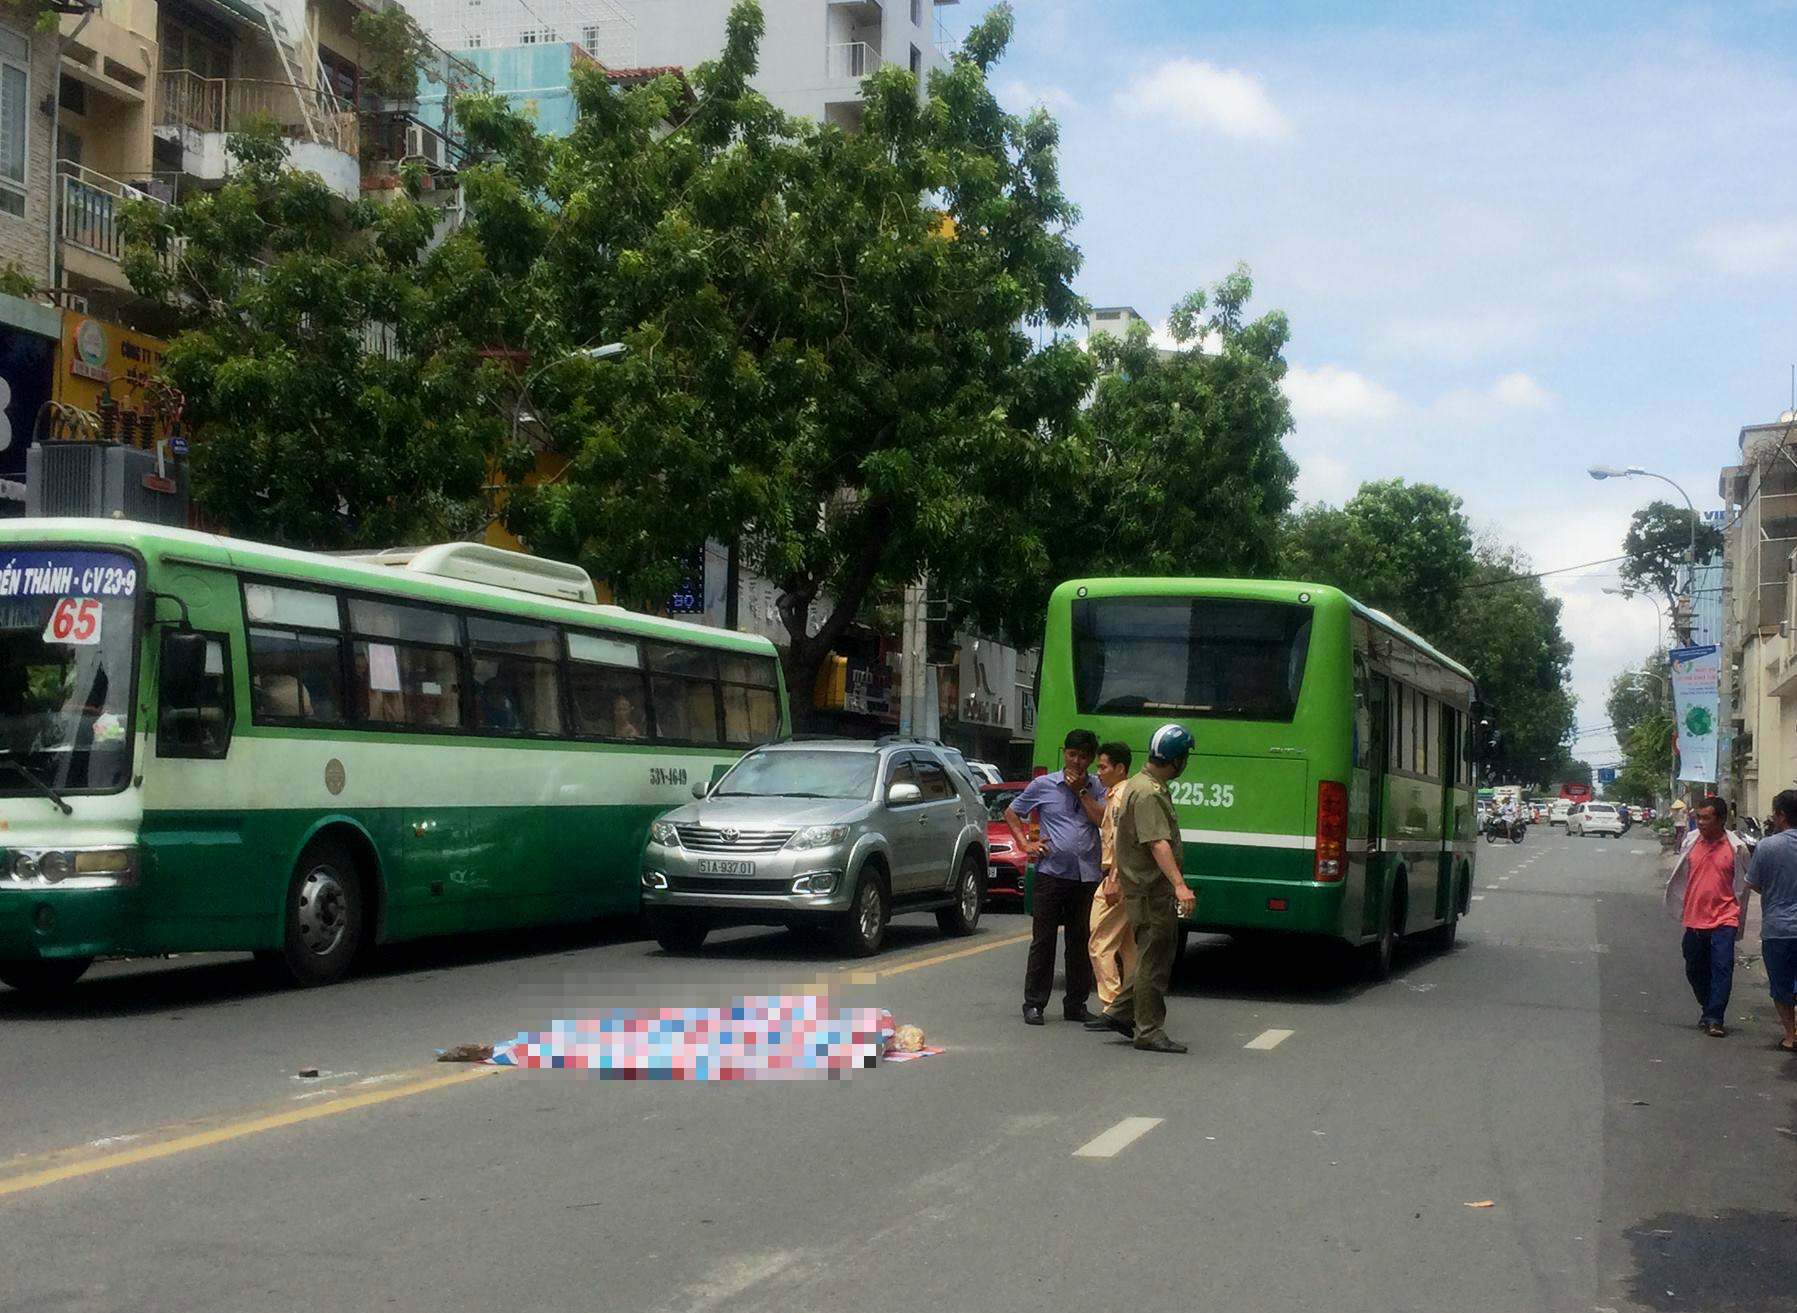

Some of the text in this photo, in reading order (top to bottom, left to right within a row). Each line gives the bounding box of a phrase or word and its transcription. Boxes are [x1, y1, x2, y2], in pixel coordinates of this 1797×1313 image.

[0, 558, 22, 596] ẾN
[23, 561, 73, 595] THÀNH
[53, 597, 99, 640] 65
[1169, 781, 1235, 808] 225.35
